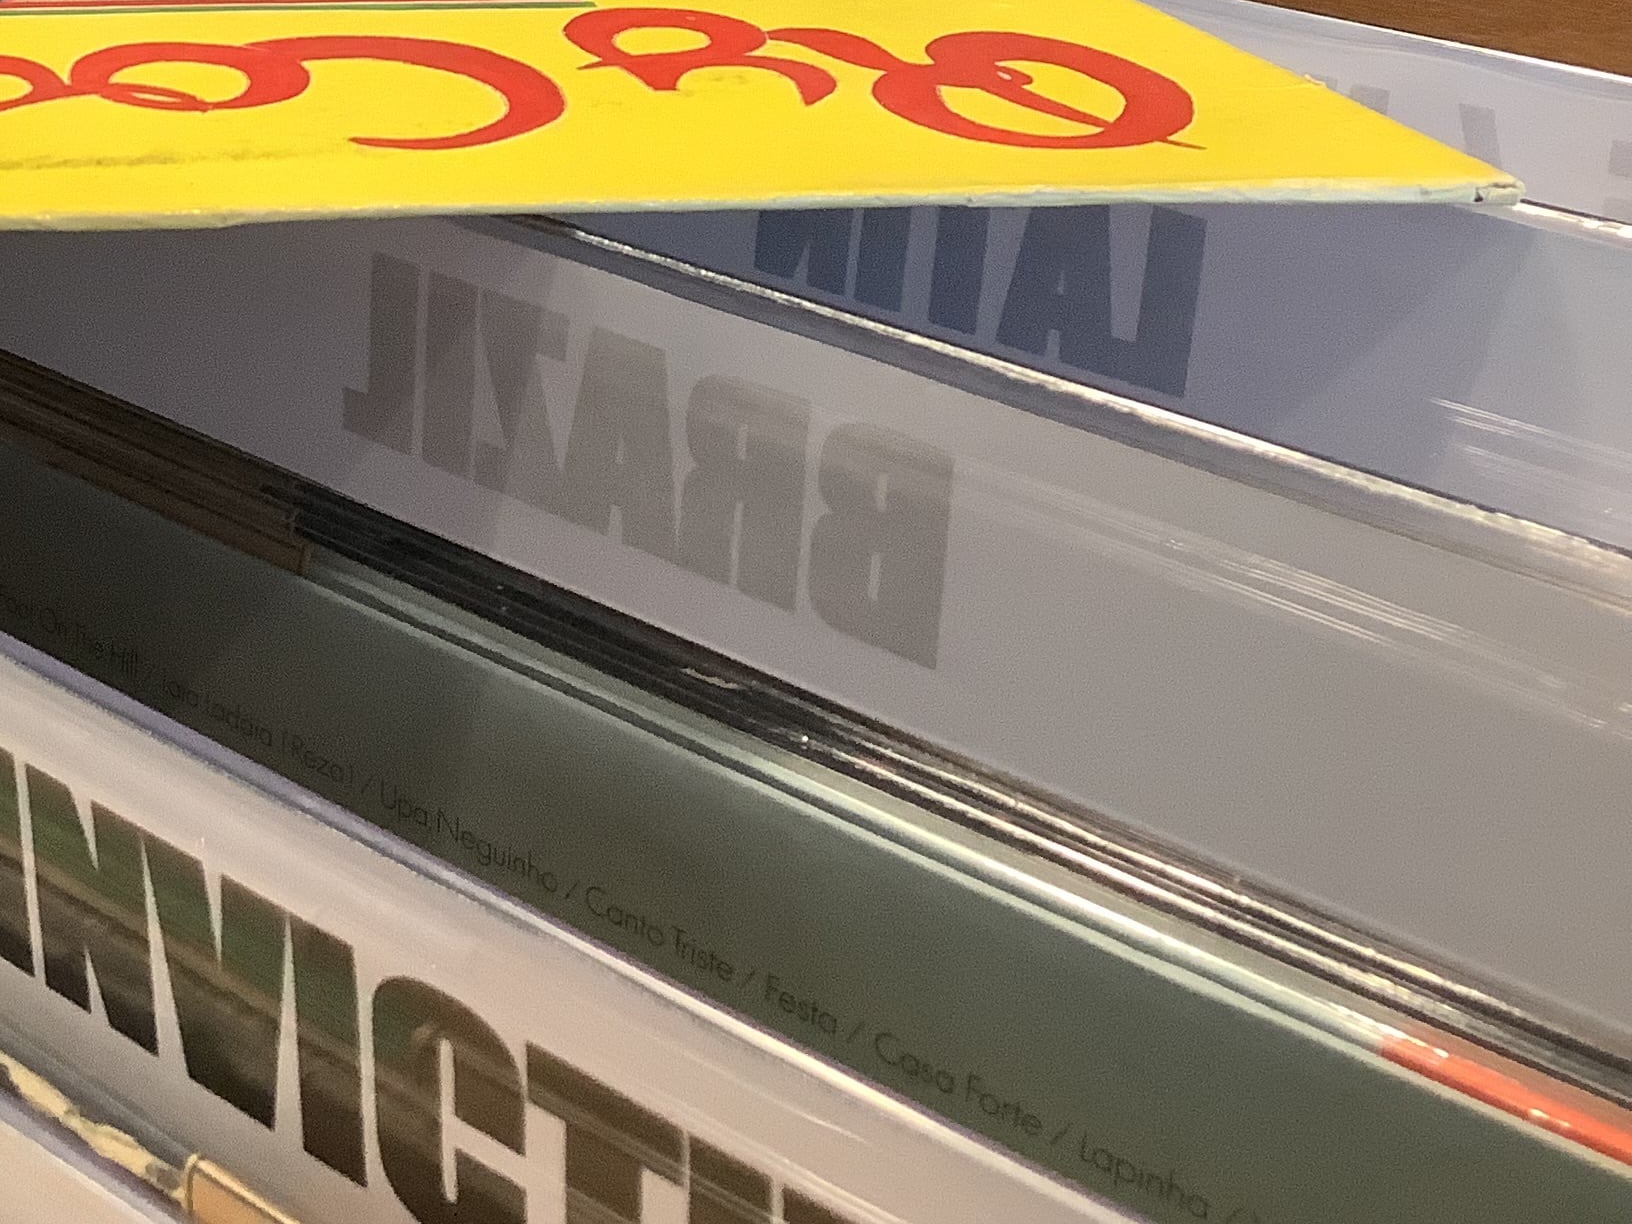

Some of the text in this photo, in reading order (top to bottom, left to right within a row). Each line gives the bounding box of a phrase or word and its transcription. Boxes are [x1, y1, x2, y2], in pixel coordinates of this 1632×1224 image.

[563, 7, 1206, 150] Ry
[564, 880, 579, 899] /
[584, 886, 666, 949] Canto
[669, 925, 737, 982] Triste
[745, 969, 758, 993] /
[767, 975, 839, 1038] Festa
[845, 1022, 863, 1044] /
[873, 1031, 955, 1096] Casa
[968, 1075, 1043, 1137] Forte
[1048, 1122, 1067, 1147] /
[1079, 1134, 1211, 1220] Lapinha
